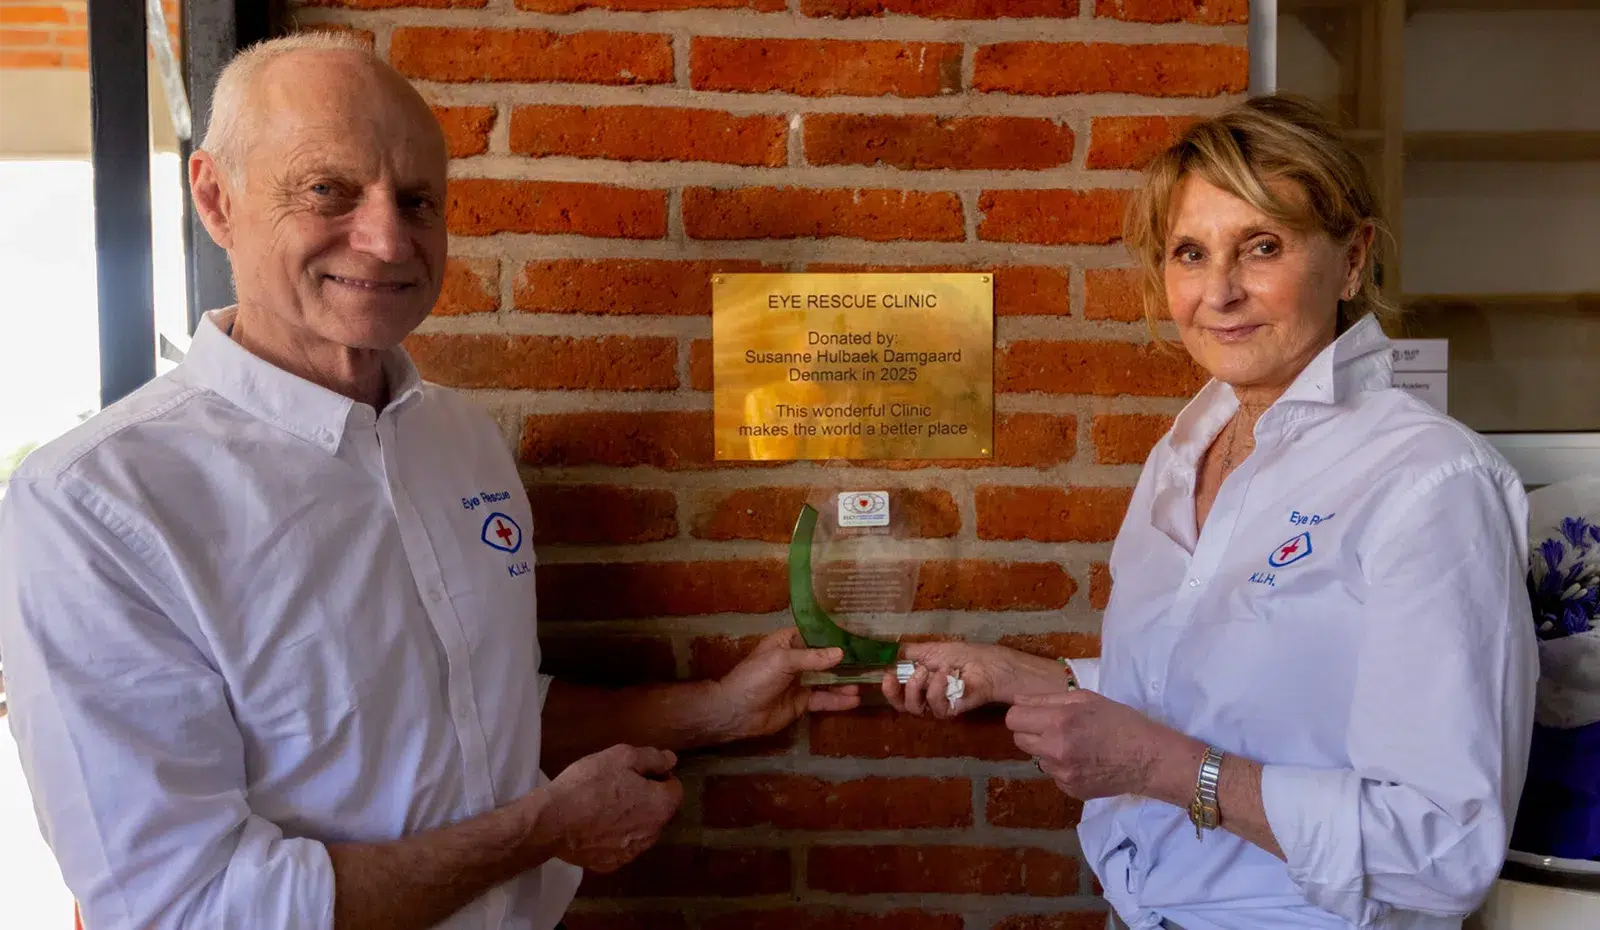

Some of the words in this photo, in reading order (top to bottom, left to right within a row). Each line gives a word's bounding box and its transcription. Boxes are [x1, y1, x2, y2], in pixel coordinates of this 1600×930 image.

[768, 294, 801, 309] EYE
[806, 294, 876, 309] RESCUE
[881, 294, 937, 309] CLINIC
[808, 331, 872, 345] Donated
[876, 331, 899, 349] by:
[745, 350, 812, 364] Susanne
[817, 349, 879, 363] Hulbaek
[884, 349, 962, 367] Damgaard
[789, 368, 858, 382] Denmark
[862, 368, 875, 381] in
[880, 368, 917, 382] 2025
[776, 404, 808, 418] This
[812, 404, 886, 418] wonderful
[890, 403, 932, 417] Clinic
[739, 423, 789, 437] makes
[793, 422, 817, 436] the
[821, 422, 862, 436] world
[866, 425, 876, 436] a
[880, 421, 923, 435] better
[927, 421, 968, 437] place
[461, 497, 481, 510] Eye
[480, 491, 511, 504] Rescue
[1290, 510, 1309, 526] Eye
